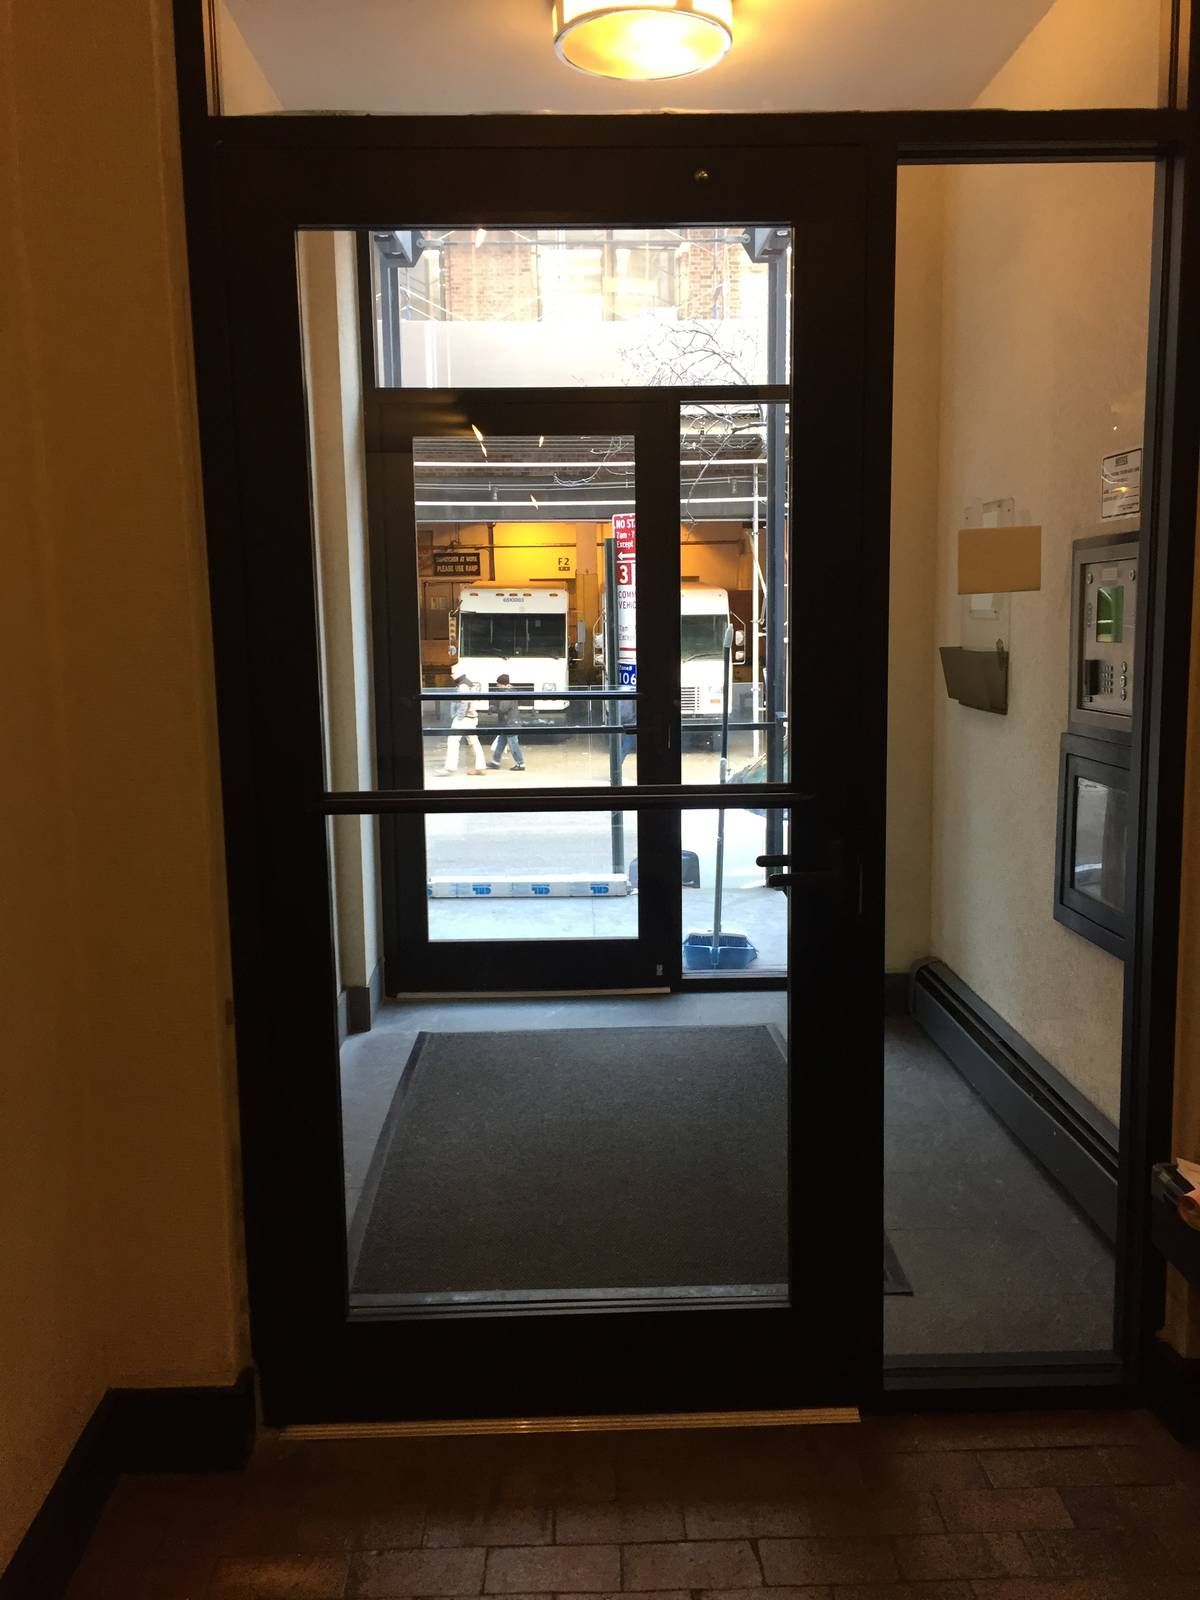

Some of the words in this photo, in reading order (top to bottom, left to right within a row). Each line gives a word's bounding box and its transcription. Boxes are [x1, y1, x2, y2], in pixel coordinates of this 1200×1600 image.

[616, 520, 625, 529] NO
[626, 519, 636, 529] ST
[619, 564, 629, 584] 3
